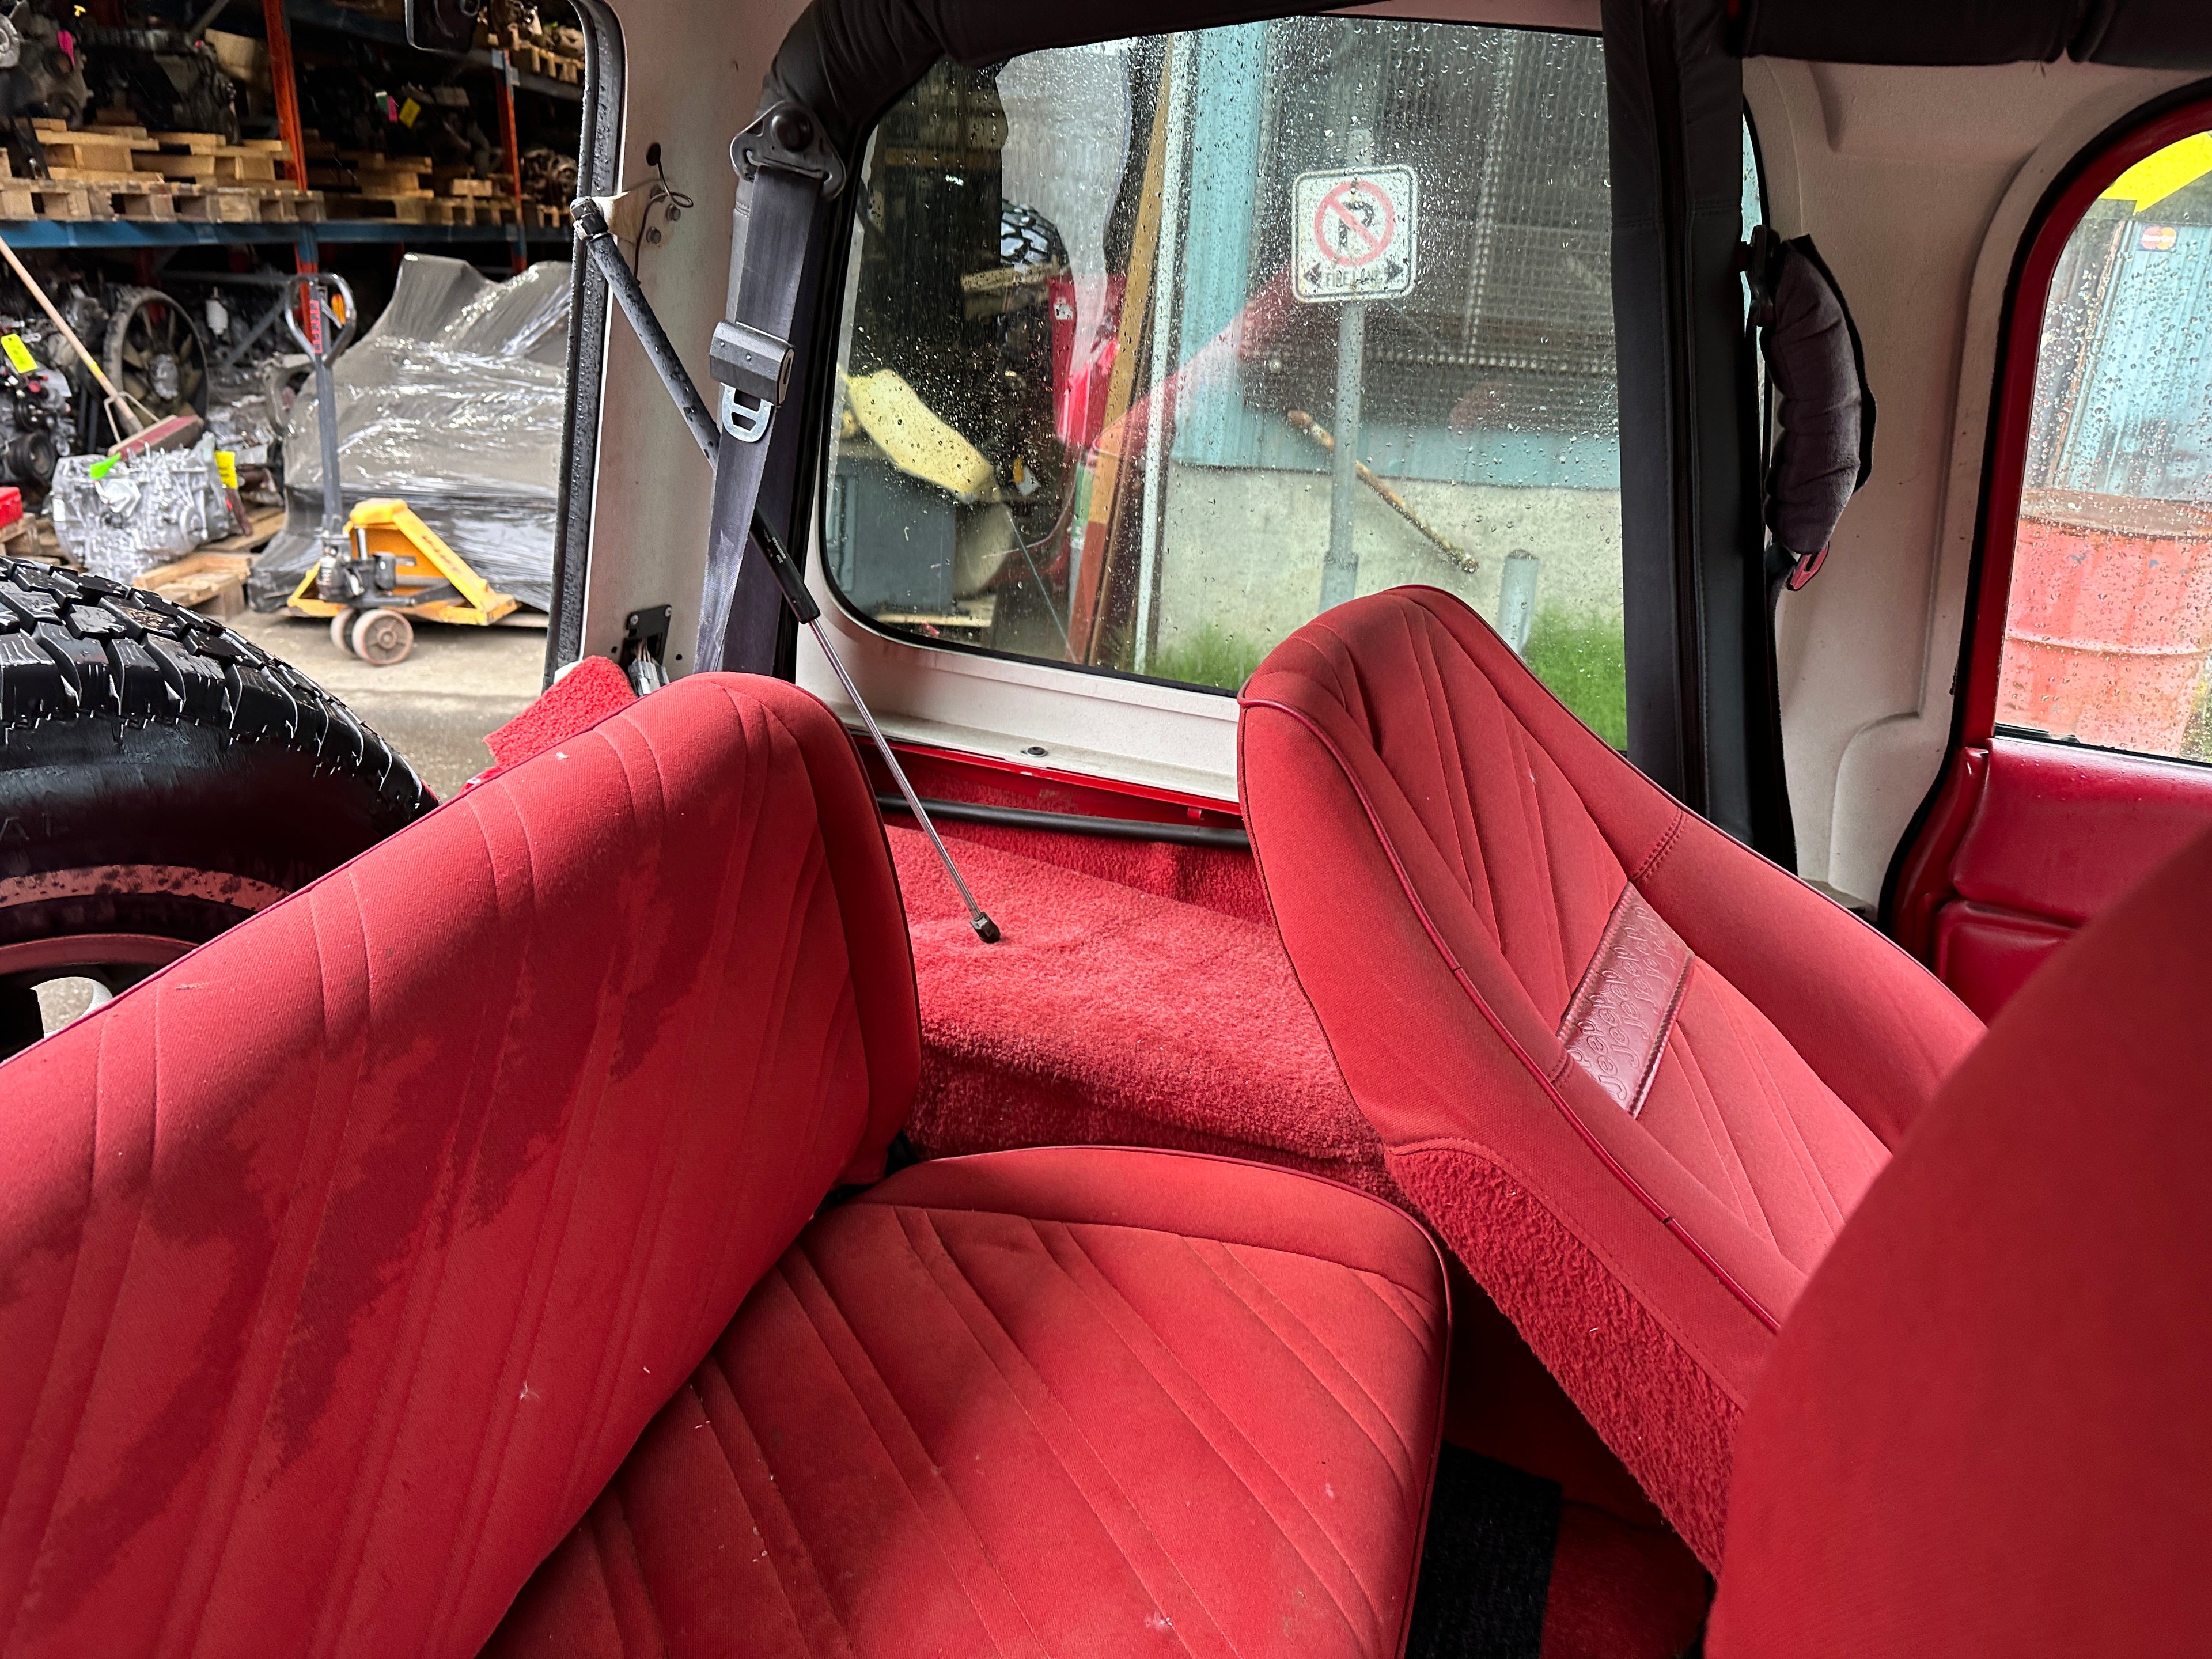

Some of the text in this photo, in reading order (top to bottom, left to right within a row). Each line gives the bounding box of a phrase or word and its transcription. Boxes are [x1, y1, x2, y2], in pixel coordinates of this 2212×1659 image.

[1600, 969, 1650, 1040] Jeep
[1613, 946, 1662, 1015] Jeep
[1575, 1019, 1627, 1100] Jeep
[1588, 995, 1641, 1067] Jeep
